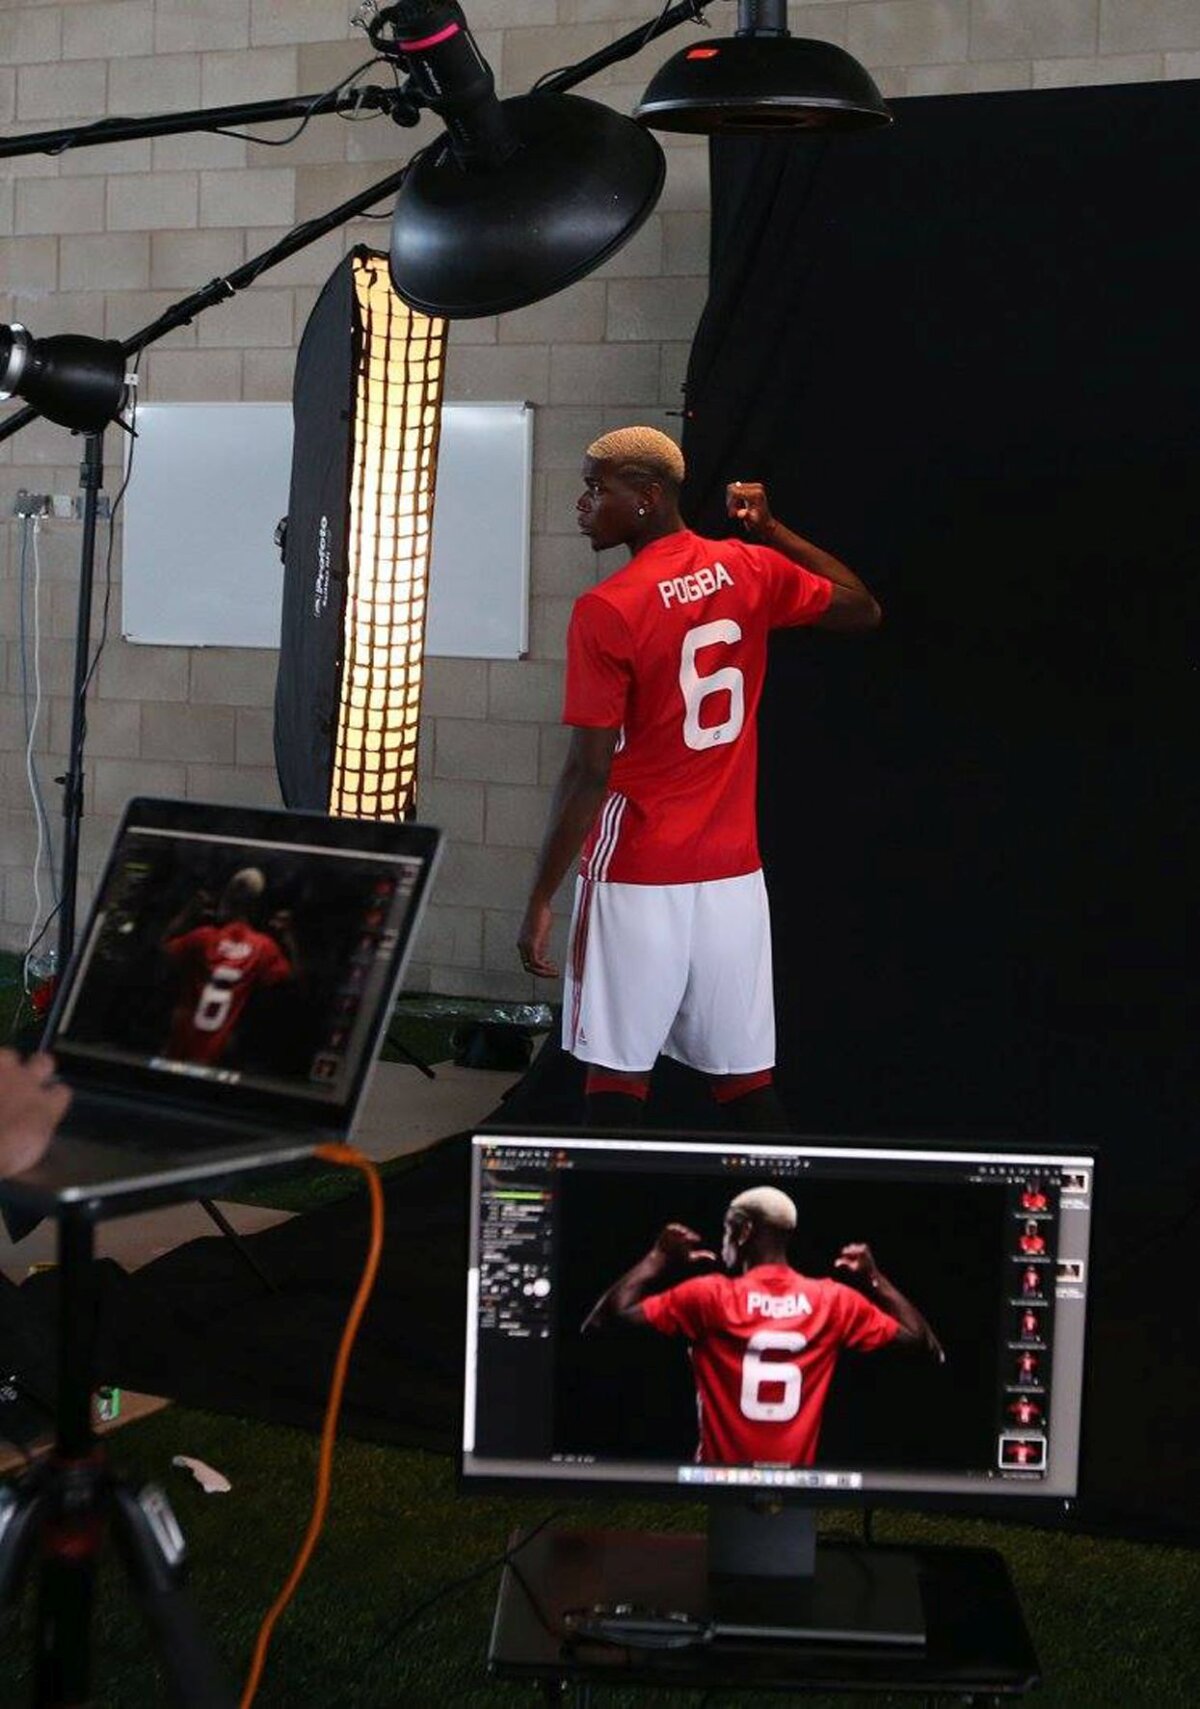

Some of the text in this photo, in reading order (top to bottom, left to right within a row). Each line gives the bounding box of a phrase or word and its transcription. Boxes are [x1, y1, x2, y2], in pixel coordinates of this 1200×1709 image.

[658, 561, 735, 609] POGBA
[679, 618, 745, 751] 6
[740, 1330, 808, 1422] 6
